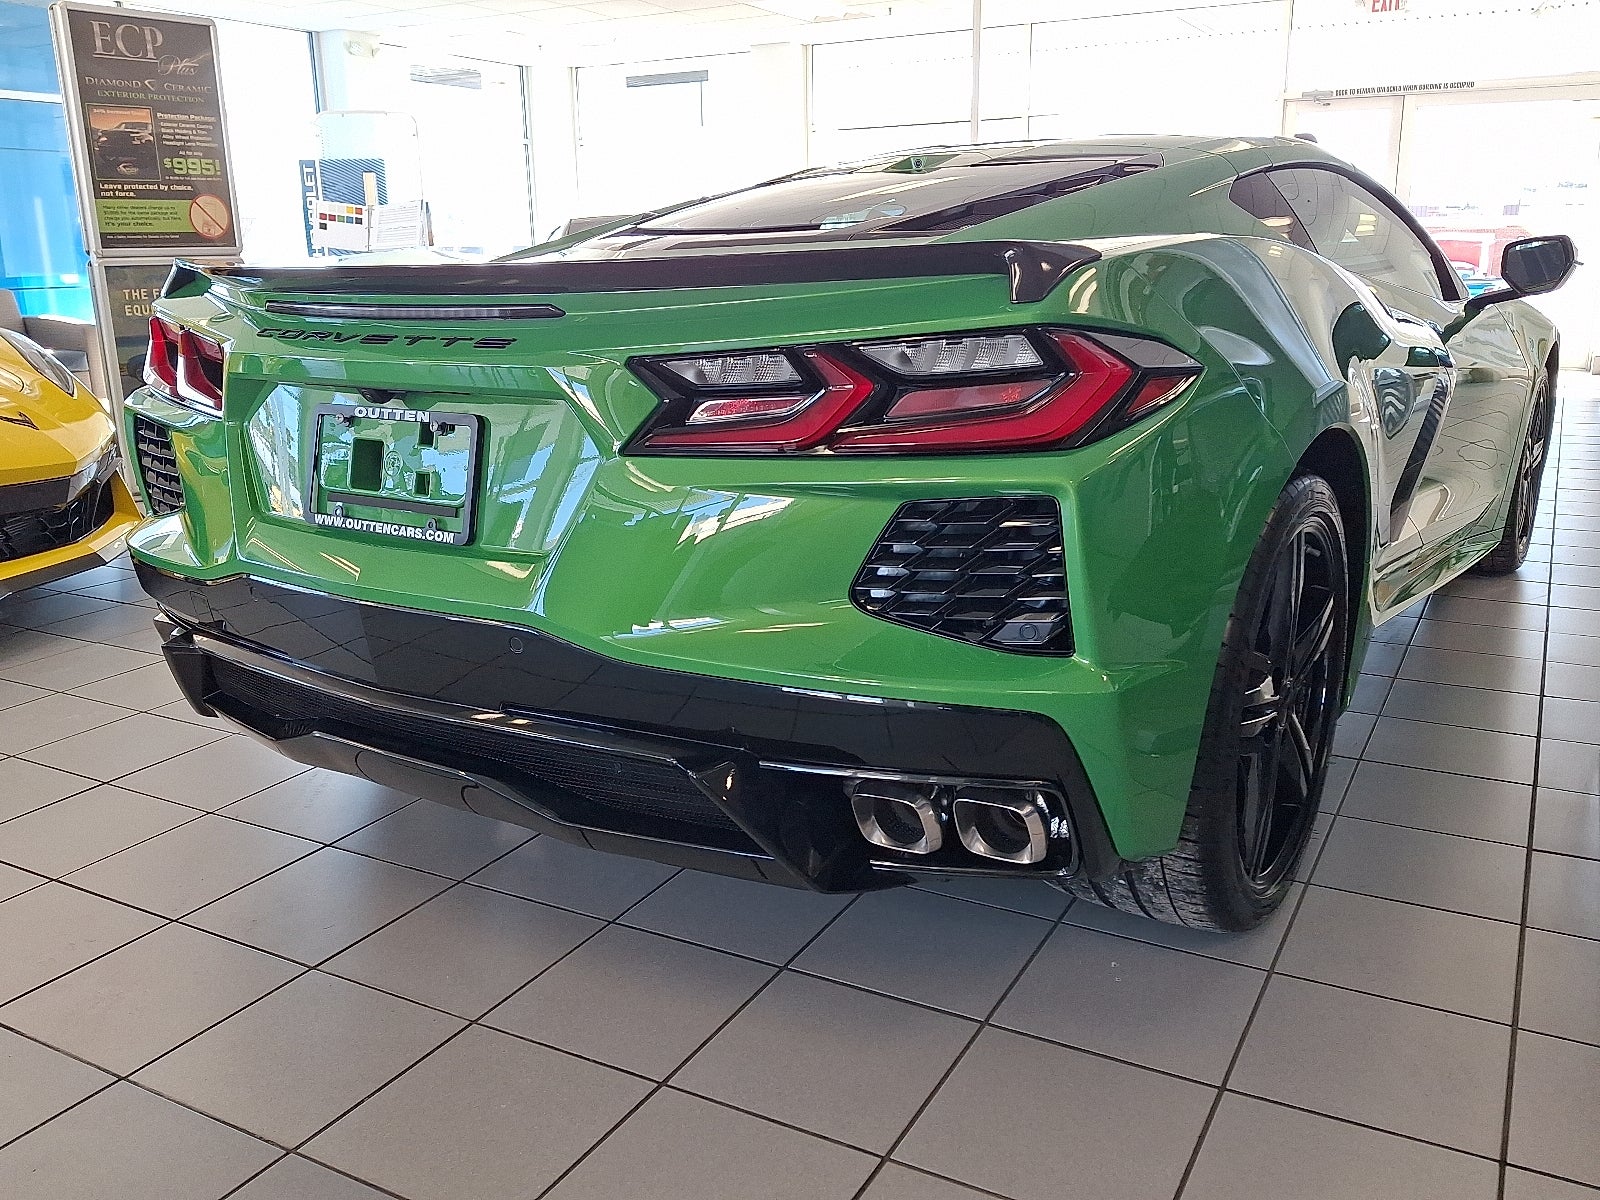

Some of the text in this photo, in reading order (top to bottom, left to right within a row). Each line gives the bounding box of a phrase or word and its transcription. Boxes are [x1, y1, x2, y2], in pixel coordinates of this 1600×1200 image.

[89, 20, 163, 59] ECP
[84, 76, 212, 94] DIAMOND CERAMIC
[97, 90, 205, 103] EXTERIOR PROTECTION
[163, 157, 221, 176] $995!
[99, 182, 122, 190] Leave
[123, 183, 159, 191] protected
[159, 184, 168, 192] by
[122, 288, 149, 300] THE
[125, 304, 155, 317] EQUI
[256, 327, 518, 350] CORVETTE
[354, 406, 430, 423] OUTTEN
[314, 513, 455, 544] WWW.OUTTENCARS.COM
